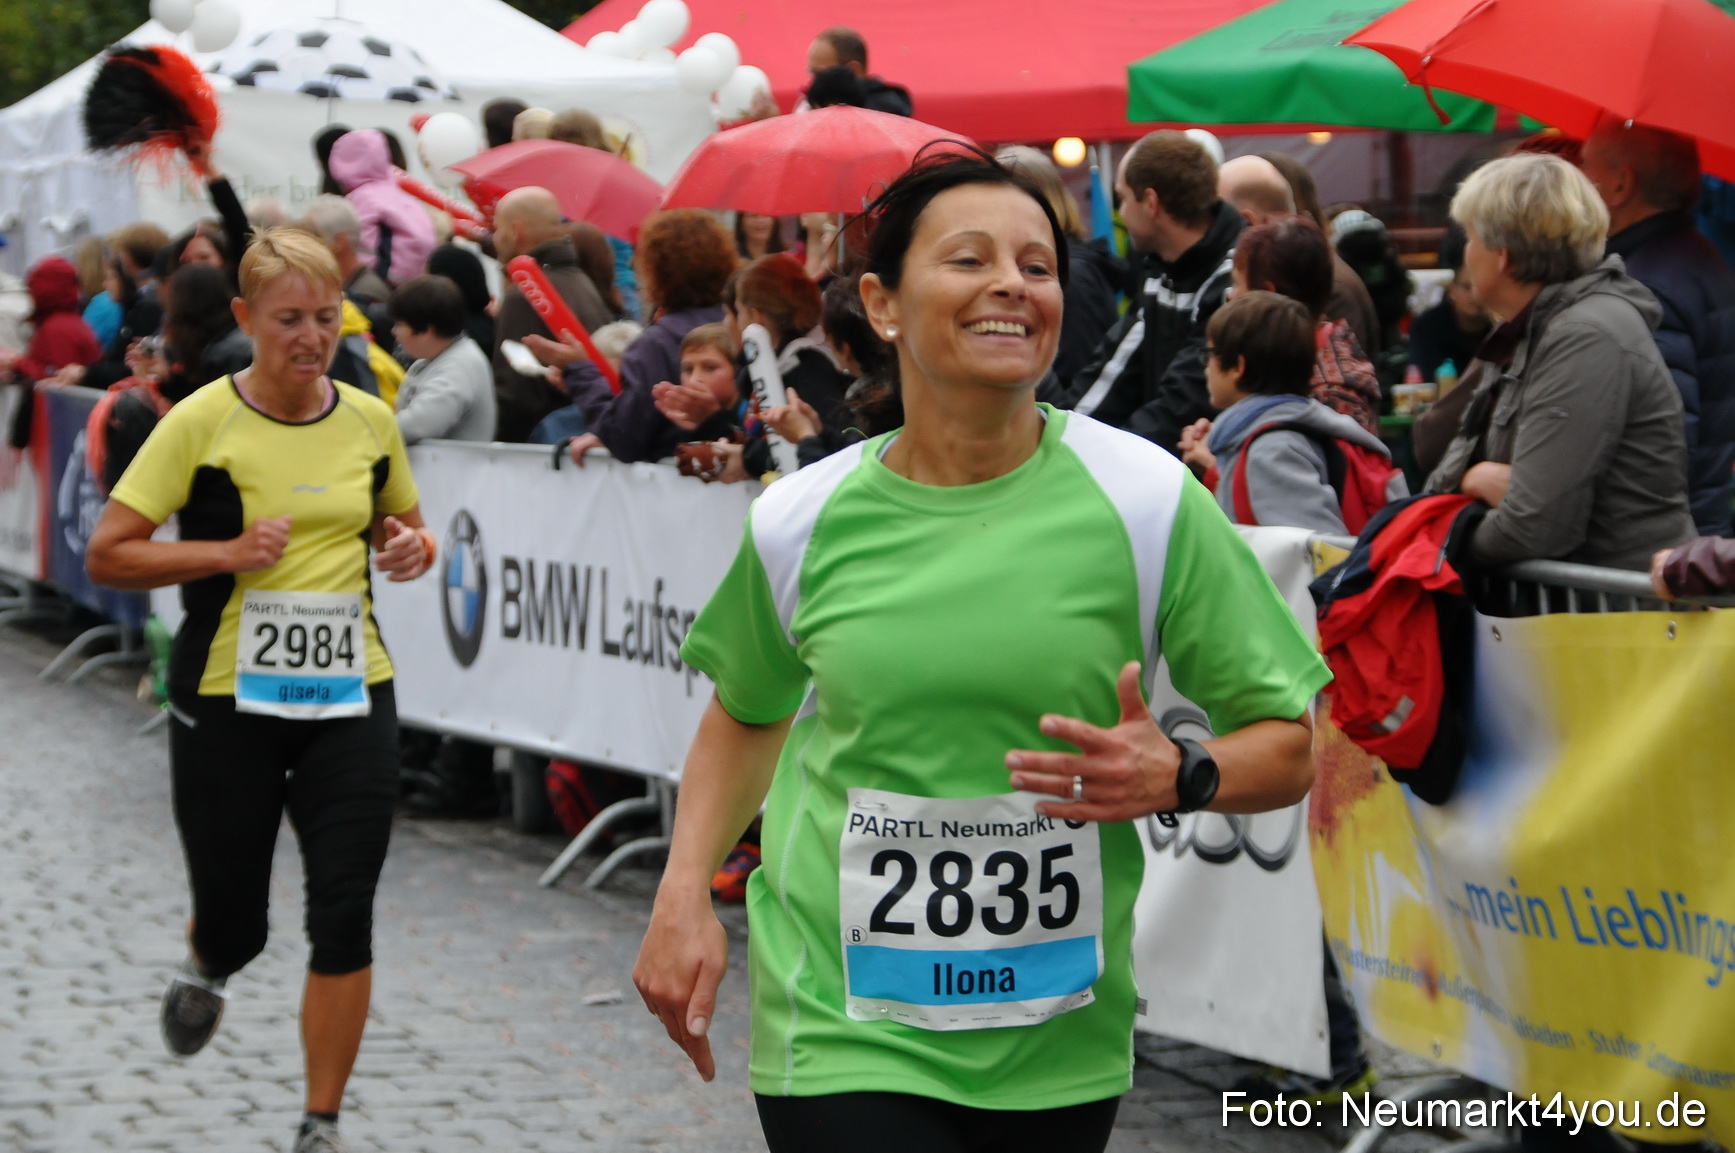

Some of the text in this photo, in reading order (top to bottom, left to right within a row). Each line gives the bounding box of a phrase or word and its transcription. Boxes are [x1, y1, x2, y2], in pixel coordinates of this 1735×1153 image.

[243, 602, 346, 617] PARTL Neumarkt
[501, 554, 592, 651] BMW
[252, 621, 355, 669] 2984
[278, 682, 330, 702] gisela
[848, 811, 1055, 838] PARTL Neumarkt
[869, 843, 1080, 938] 2835
[851, 928, 861, 942] B
[933, 963, 1016, 996] Ilona
